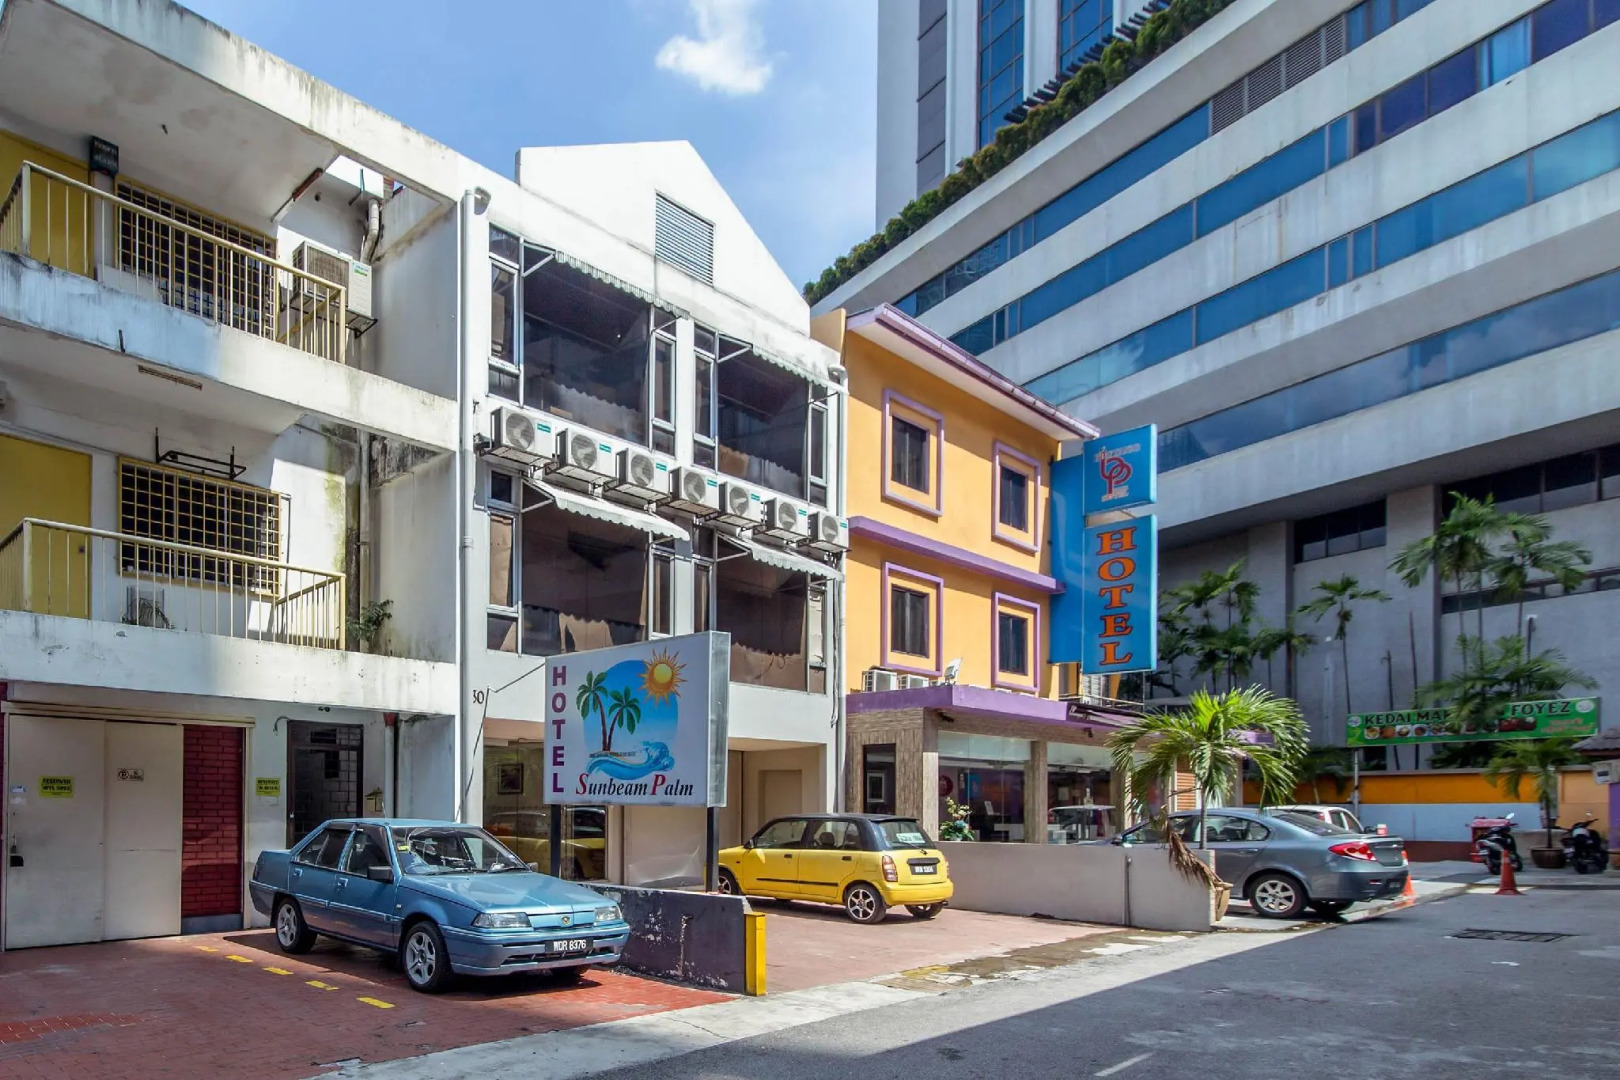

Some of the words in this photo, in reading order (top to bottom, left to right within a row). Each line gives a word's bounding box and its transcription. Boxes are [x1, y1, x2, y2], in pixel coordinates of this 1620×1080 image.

[1096, 526, 1137, 666] HOTEL
[1364, 712, 1411, 725] KEDAI
[1511, 701, 1571, 716] FOYEZ
[551, 665, 567, 793] HOTEL
[575, 772, 648, 796] Sunbeam
[650, 774, 694, 796] Palm
[553, 941, 568, 952] WDR
[569, 940, 587, 951] 8376
